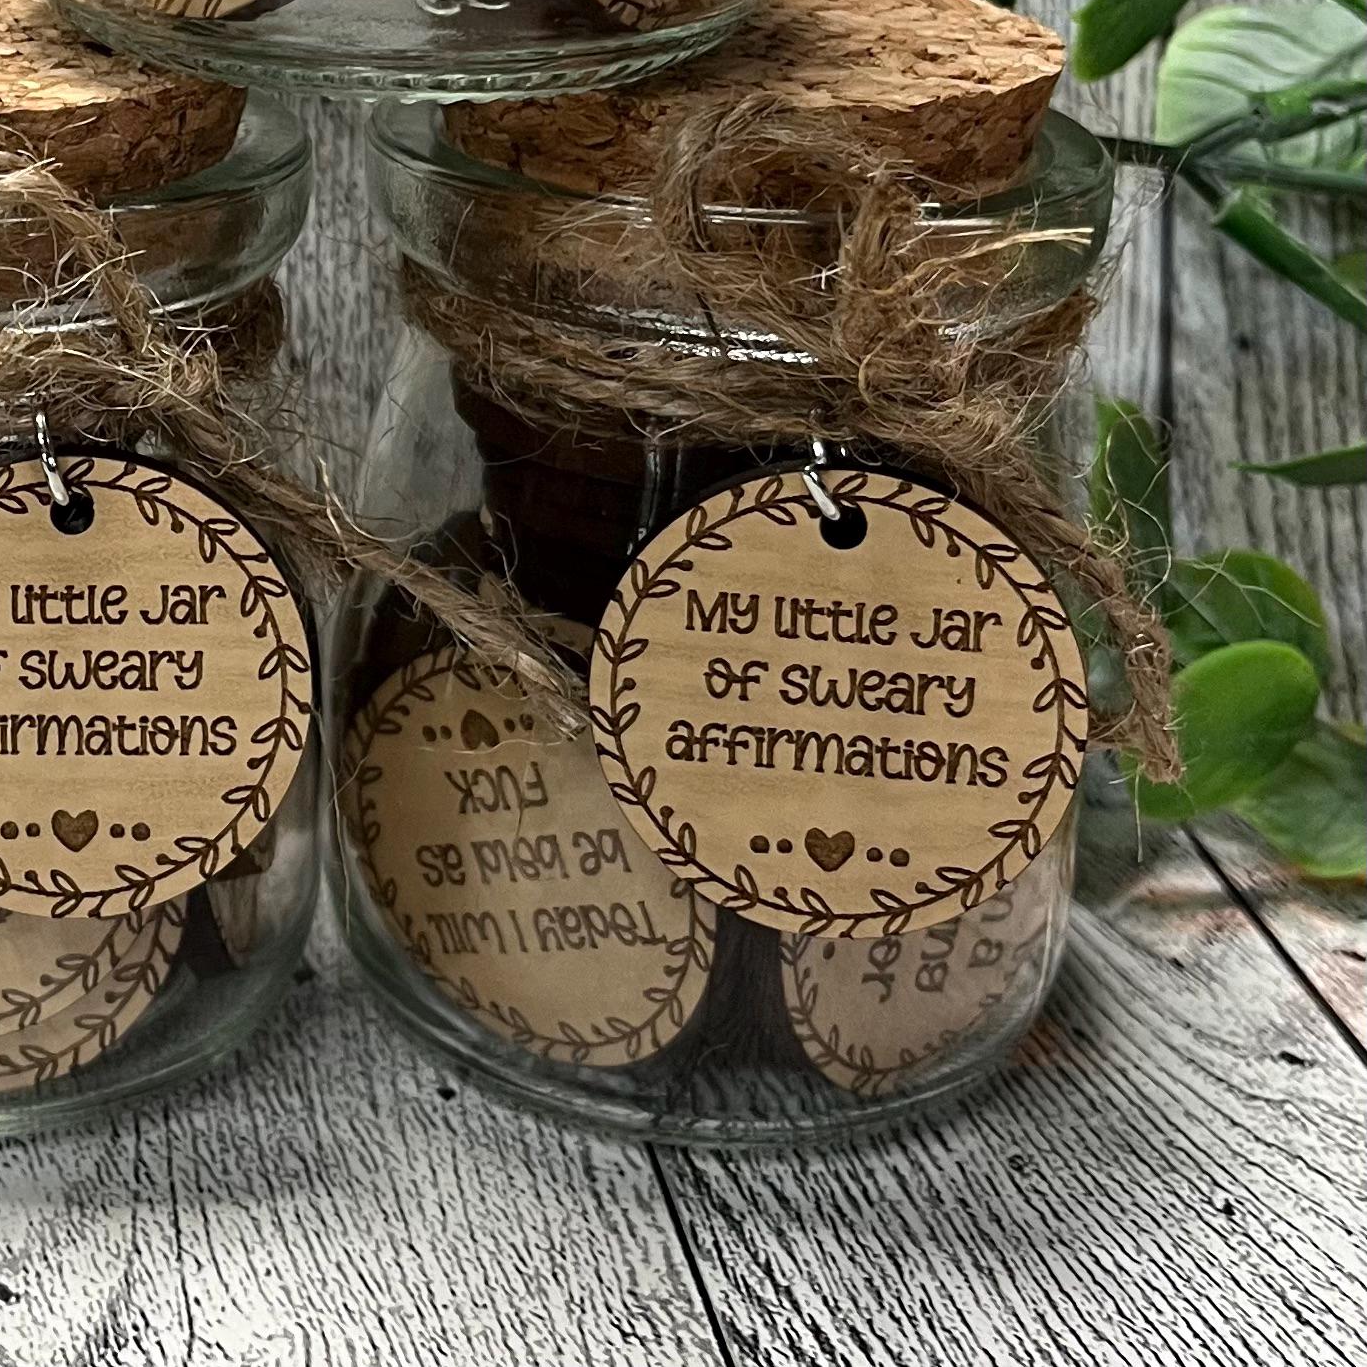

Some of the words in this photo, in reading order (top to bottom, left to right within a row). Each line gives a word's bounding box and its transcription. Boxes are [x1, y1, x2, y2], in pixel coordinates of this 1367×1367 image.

[685, 589, 760, 634] My
[18, 649, 204, 691] sweary
[703, 657, 769, 701] of
[779, 663, 976, 718] sweary
[665, 719, 1010, 788] affirmations
[415, 843, 466, 888] as
[572, 828, 633, 876] be
